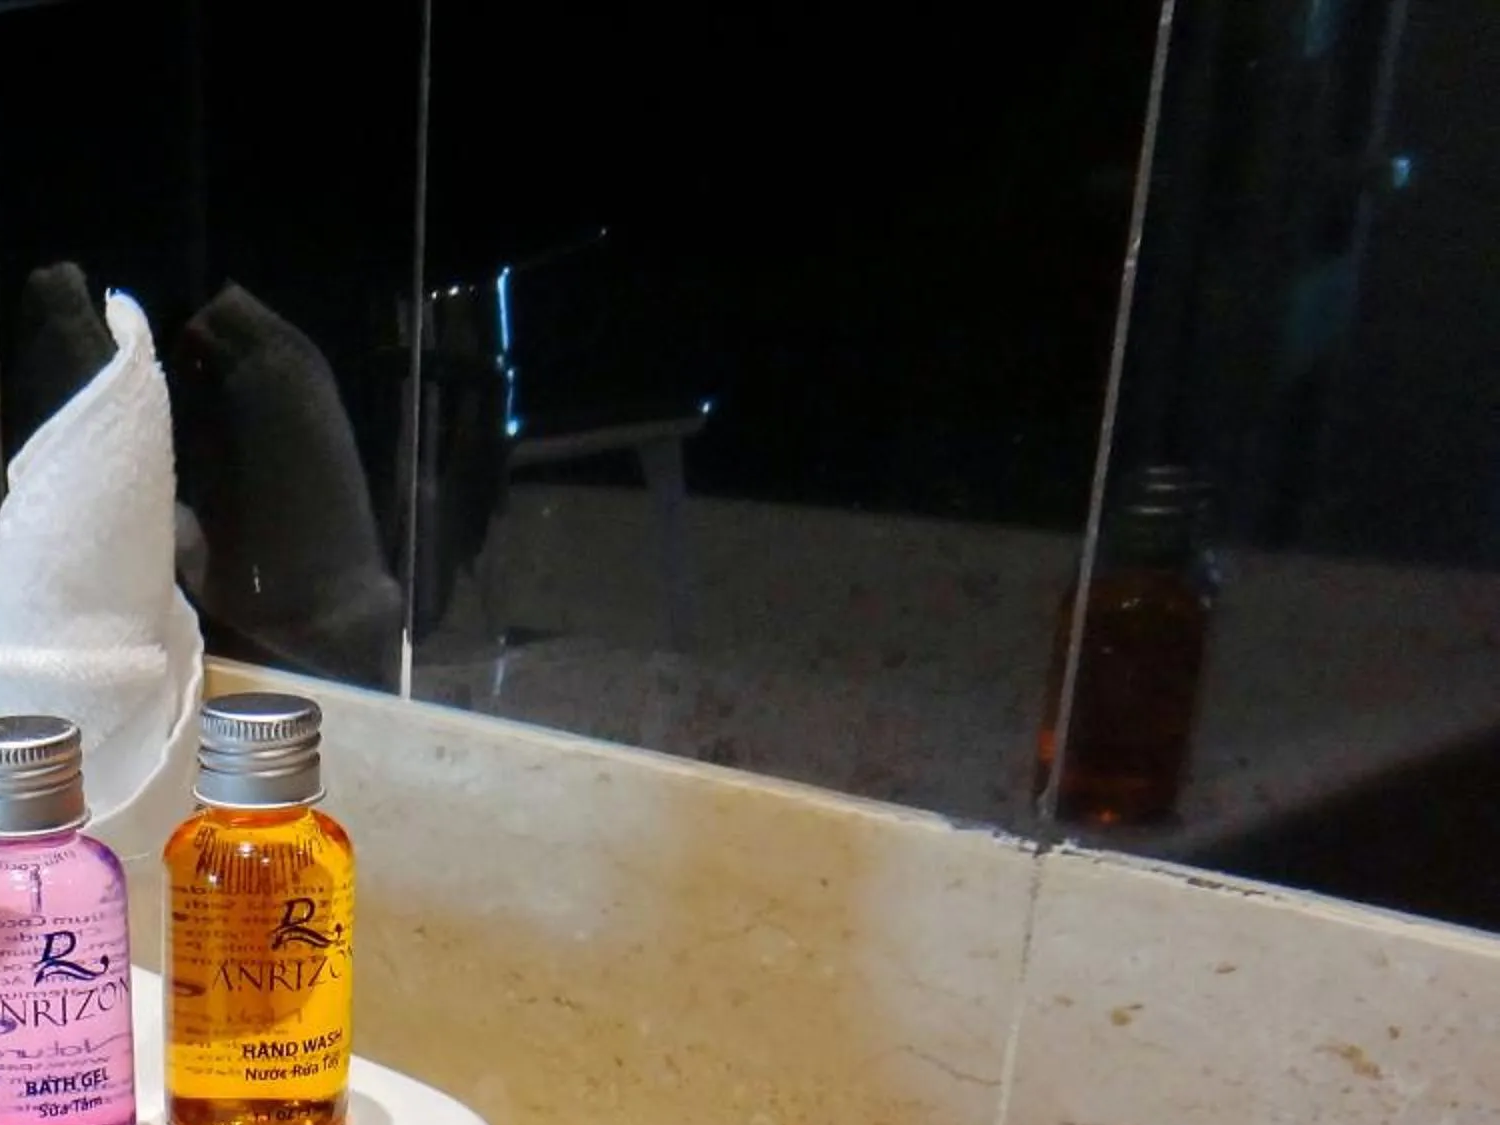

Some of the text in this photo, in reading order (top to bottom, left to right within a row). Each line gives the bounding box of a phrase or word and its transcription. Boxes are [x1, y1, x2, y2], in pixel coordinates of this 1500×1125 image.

[242, 1041, 299, 1060] HAND
[302, 1028, 343, 1054] WASH
[25, 1076, 76, 1097] BATH
[81, 1067, 109, 1089] GEL
